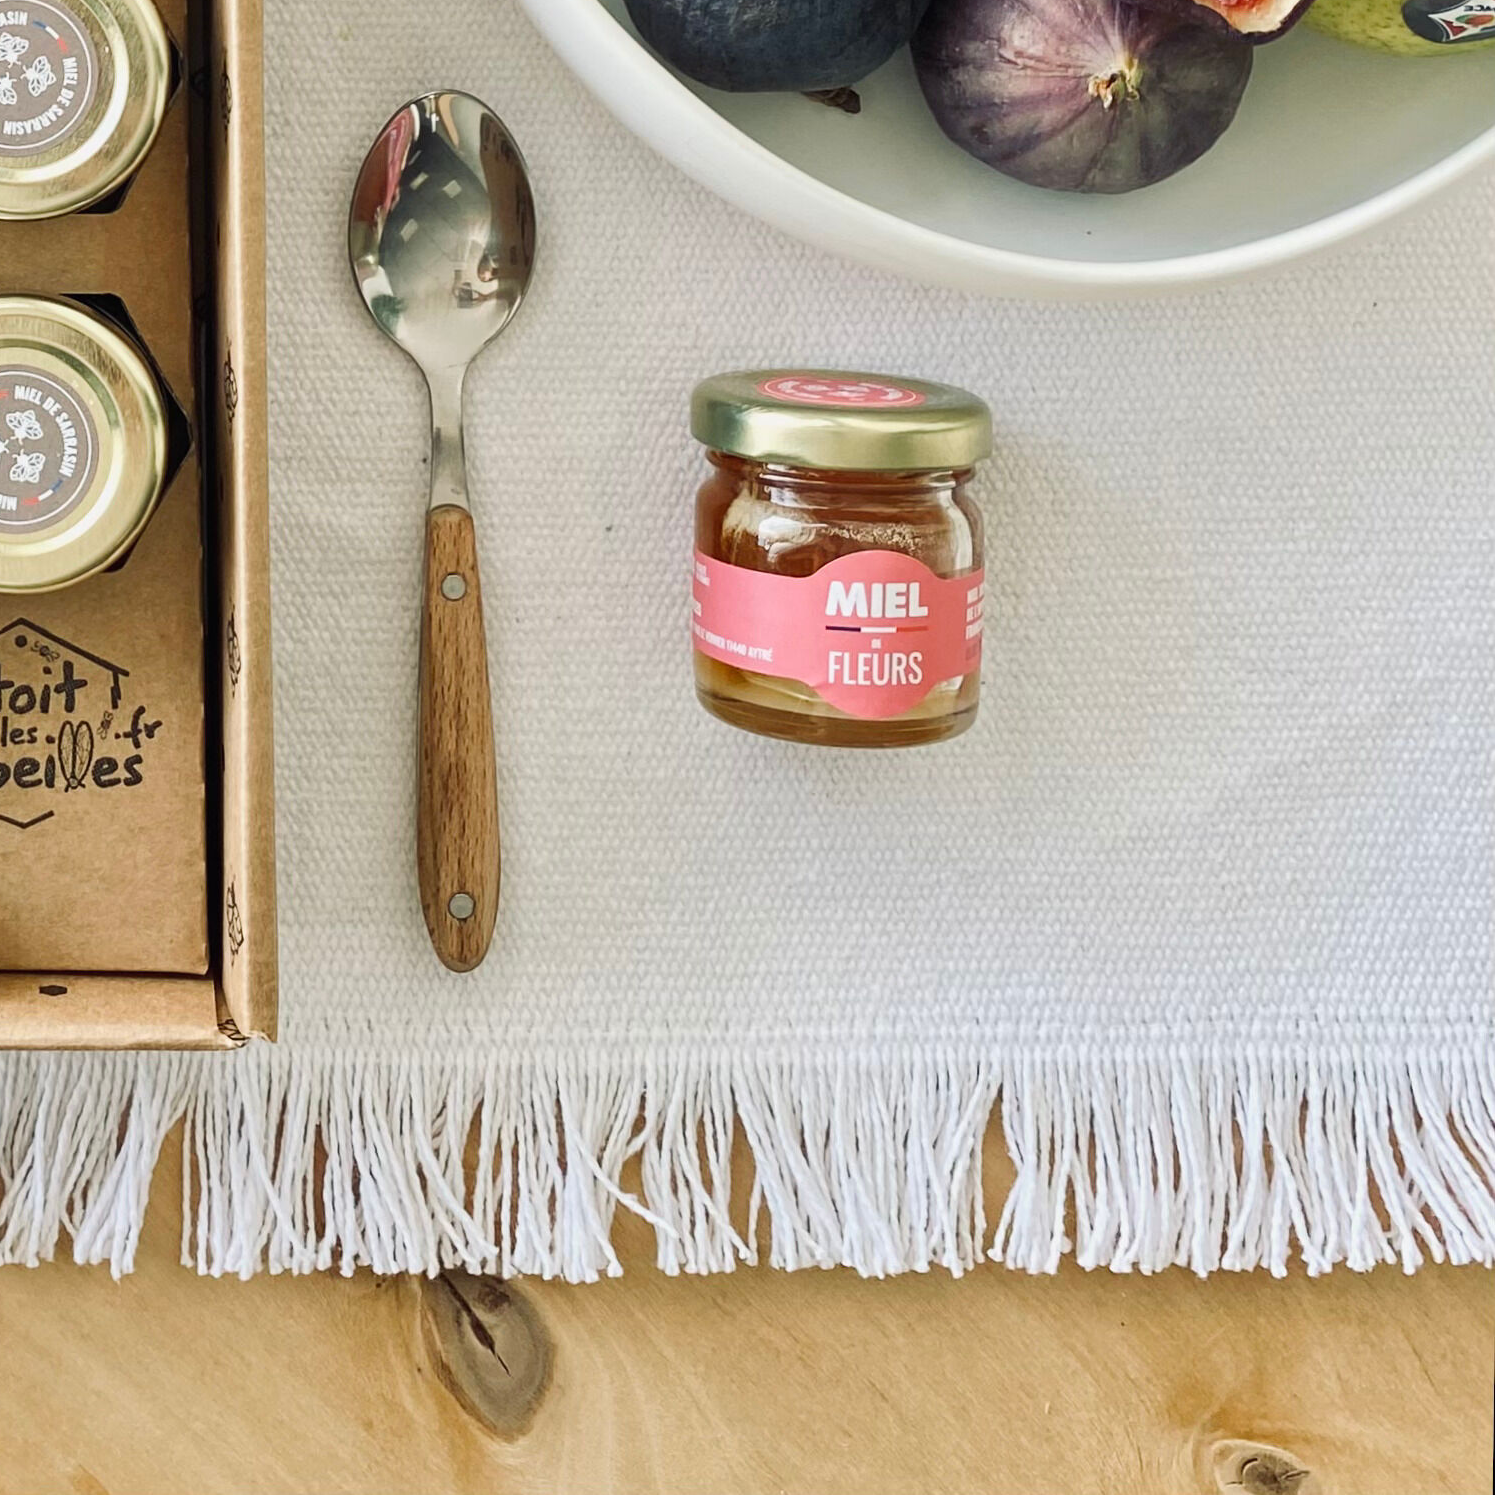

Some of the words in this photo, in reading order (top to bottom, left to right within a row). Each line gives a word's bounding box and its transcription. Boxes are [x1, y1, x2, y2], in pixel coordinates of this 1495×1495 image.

[63, 57, 77, 85] MIEL
[57, 88, 74, 107] DE
[3, 105, 63, 135] SARRASIN
[15, 385, 42, 405] MIEL
[43, 397, 61, 416] DE
[55, 413, 77, 477] SARRASIN
[825, 581, 928, 618] MIEL
[828, 651, 923, 686] FLEURS
